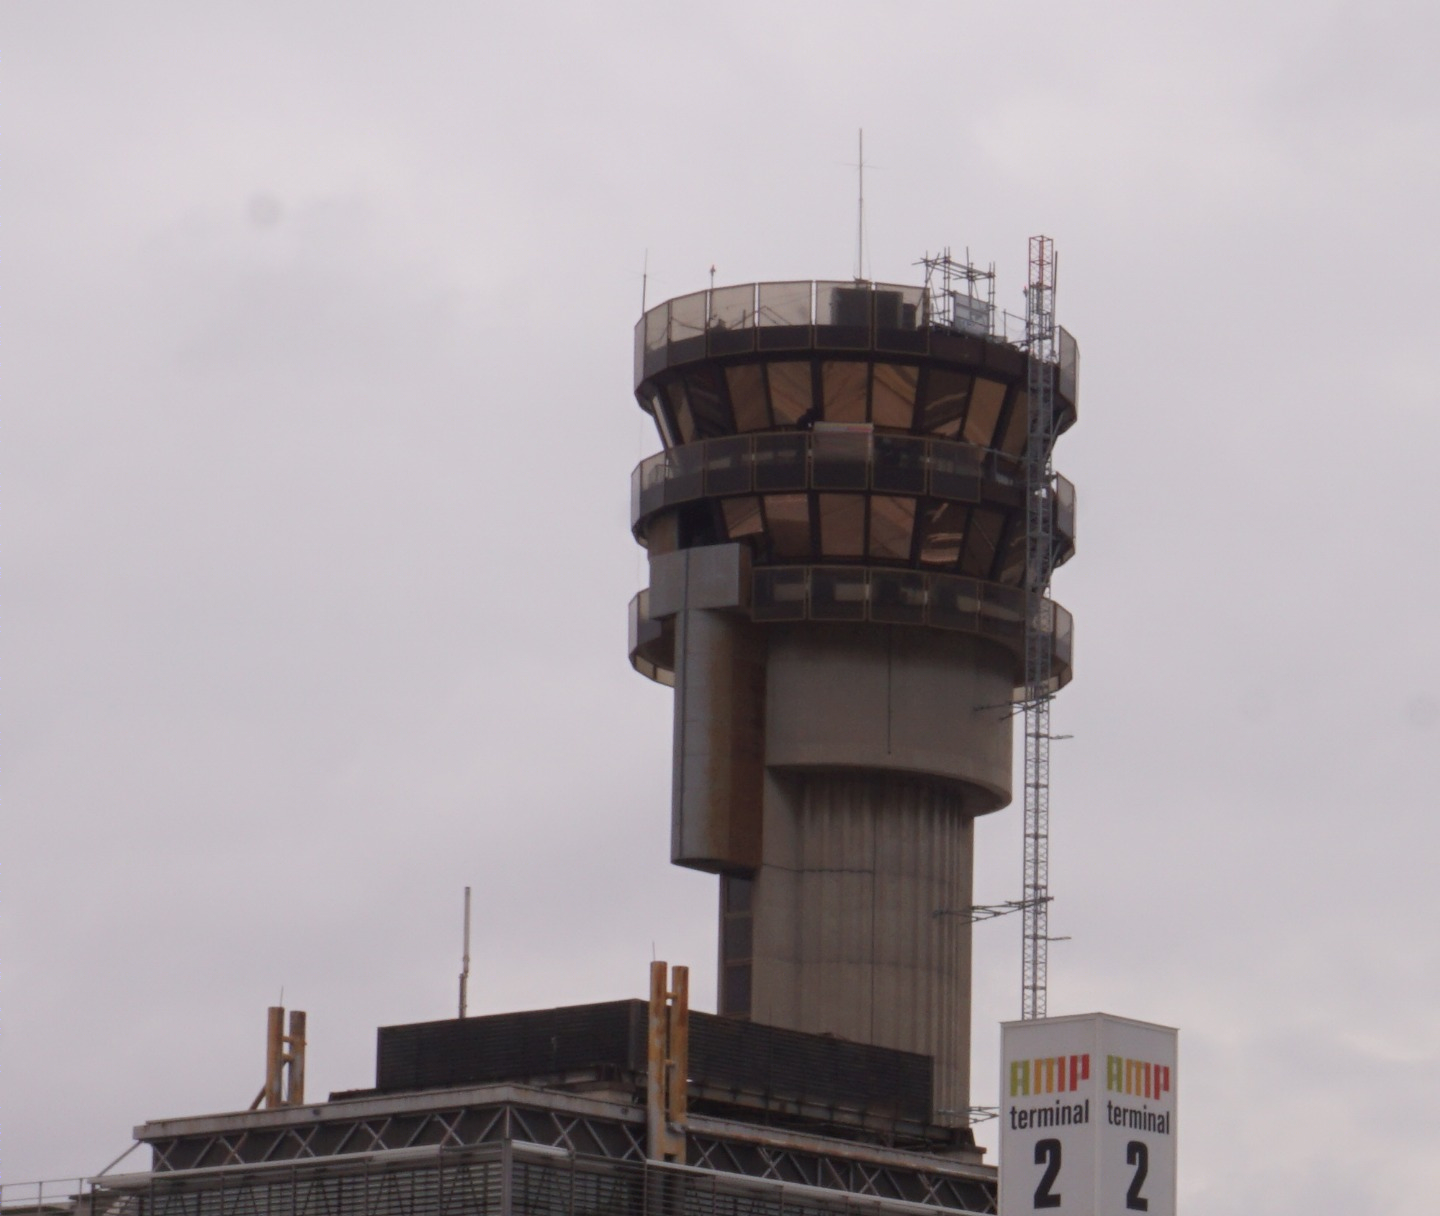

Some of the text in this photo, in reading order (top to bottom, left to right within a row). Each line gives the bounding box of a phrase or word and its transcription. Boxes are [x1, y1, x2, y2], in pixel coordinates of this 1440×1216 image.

[1010, 1099, 1090, 1130] terminal
[1107, 1100, 1170, 1135] terminal
[1033, 1138, 1062, 1209] 2
[1126, 1140, 1148, 1212] 2
